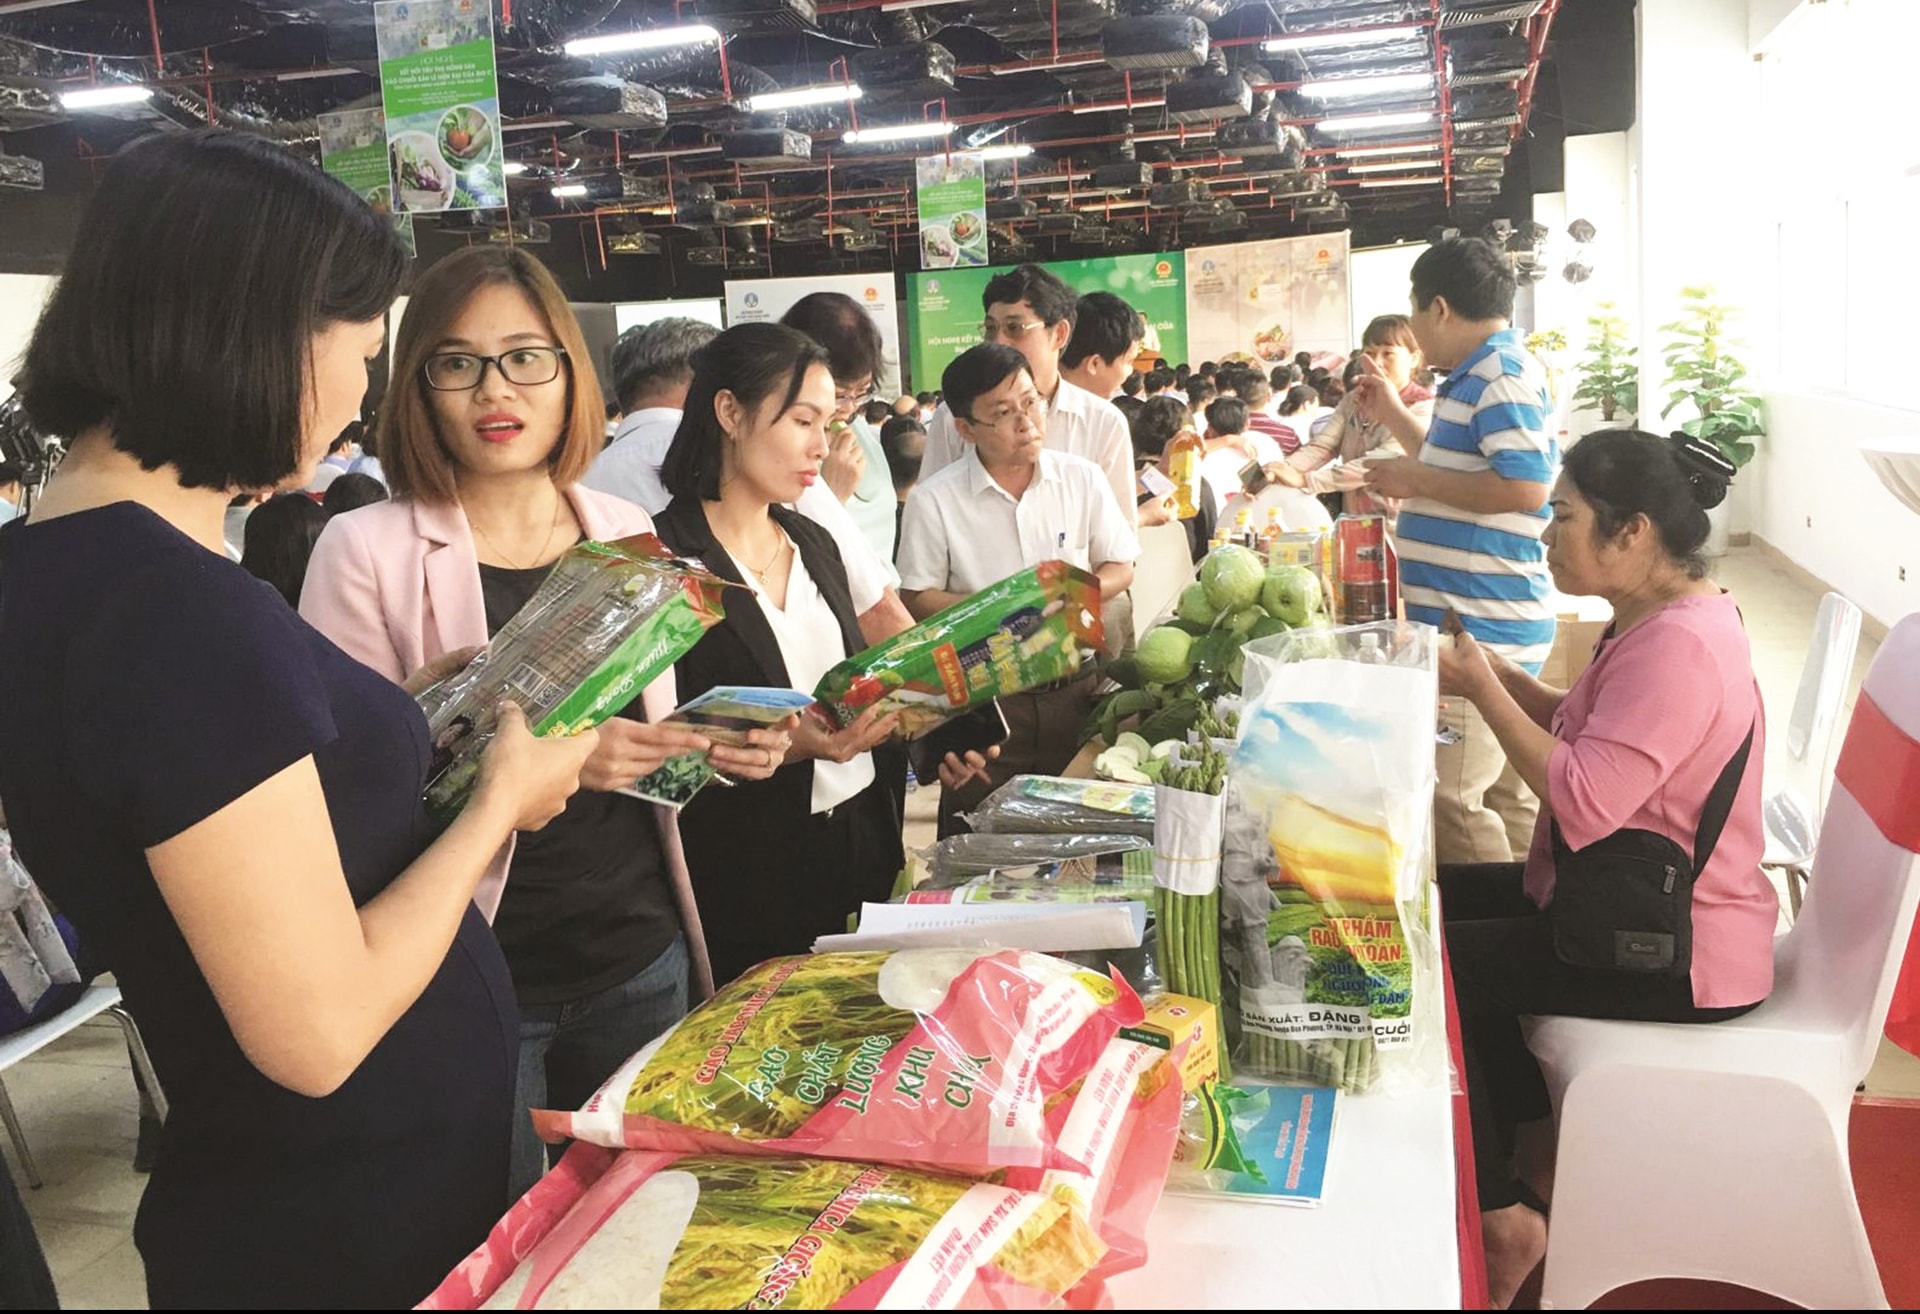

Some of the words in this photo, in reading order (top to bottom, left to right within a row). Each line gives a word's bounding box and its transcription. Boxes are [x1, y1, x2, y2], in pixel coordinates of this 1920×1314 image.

[1308, 1010, 1362, 1025] ĐẶNG
[838, 1034, 892, 1115] LƯỢNG
[895, 1046, 936, 1100] KHU
